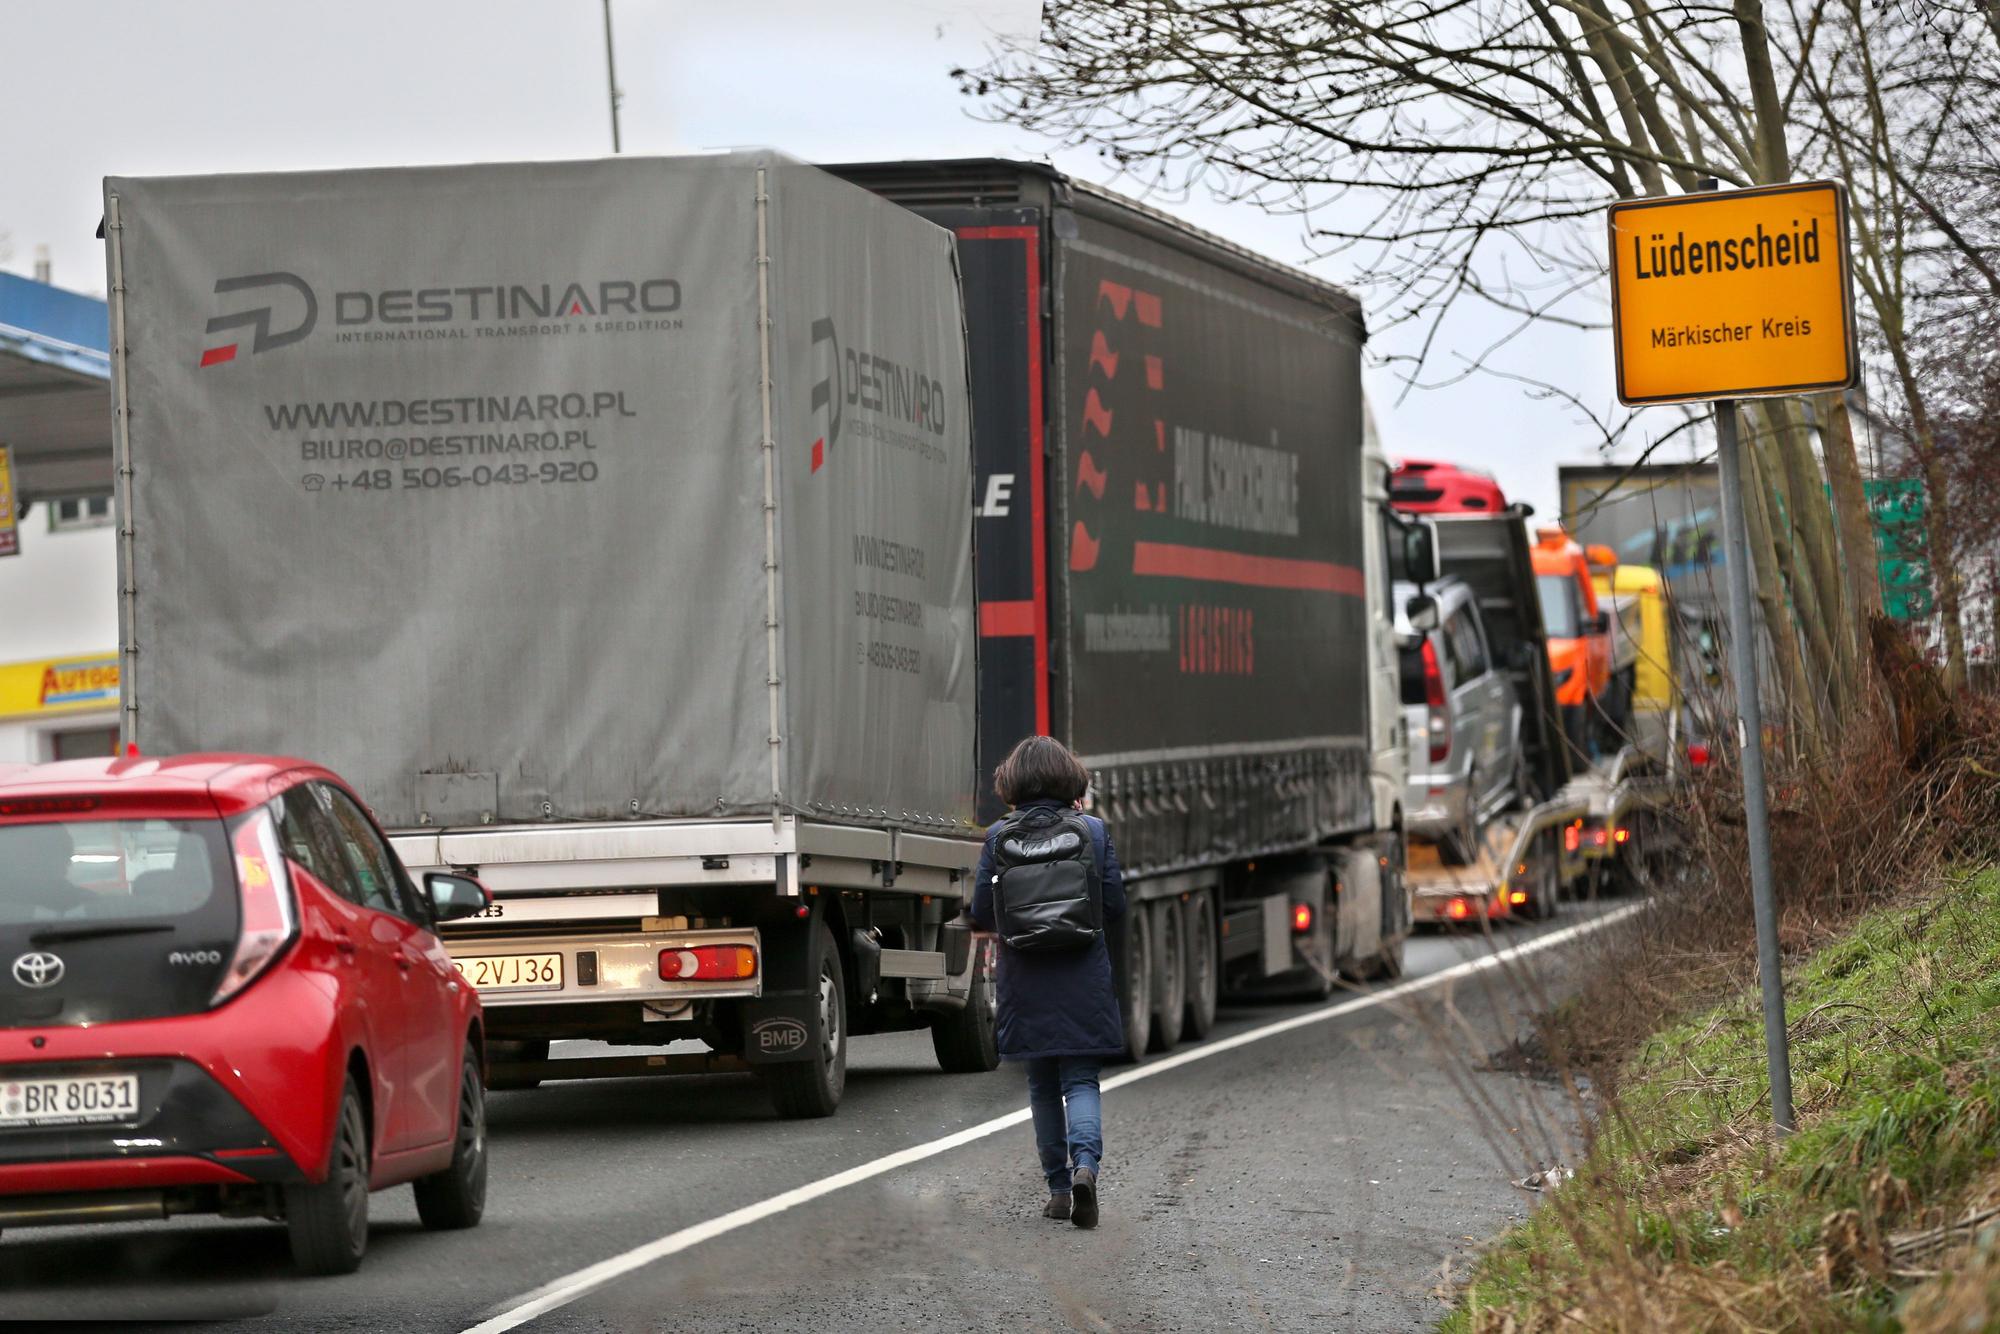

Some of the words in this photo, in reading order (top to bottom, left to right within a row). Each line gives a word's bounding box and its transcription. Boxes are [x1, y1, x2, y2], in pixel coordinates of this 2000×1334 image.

[1635, 217, 1820, 280] Lüdenscheid
[335, 278, 682, 326] DESTINARO
[335, 328, 469, 344] INTERNATIONAL
[475, 323, 571, 338] TRANSPORT
[594, 319, 684, 333] SPEDITION
[1651, 322, 1753, 349] Märkischer
[1762, 315, 1812, 339] Kreis
[846, 347, 946, 437] DESTINARO
[265, 391, 637, 431] WWW.DESTINARO.PL
[301, 431, 598, 461] BIURO@DESTINARO.PL
[402, 461, 599, 489] 506-043-920
[476, 958, 555, 985] 2VJ36
[760, 1029, 802, 1047] BMB
[25, 1084, 59, 1113] BR
[66, 1081, 133, 1111] 8031
